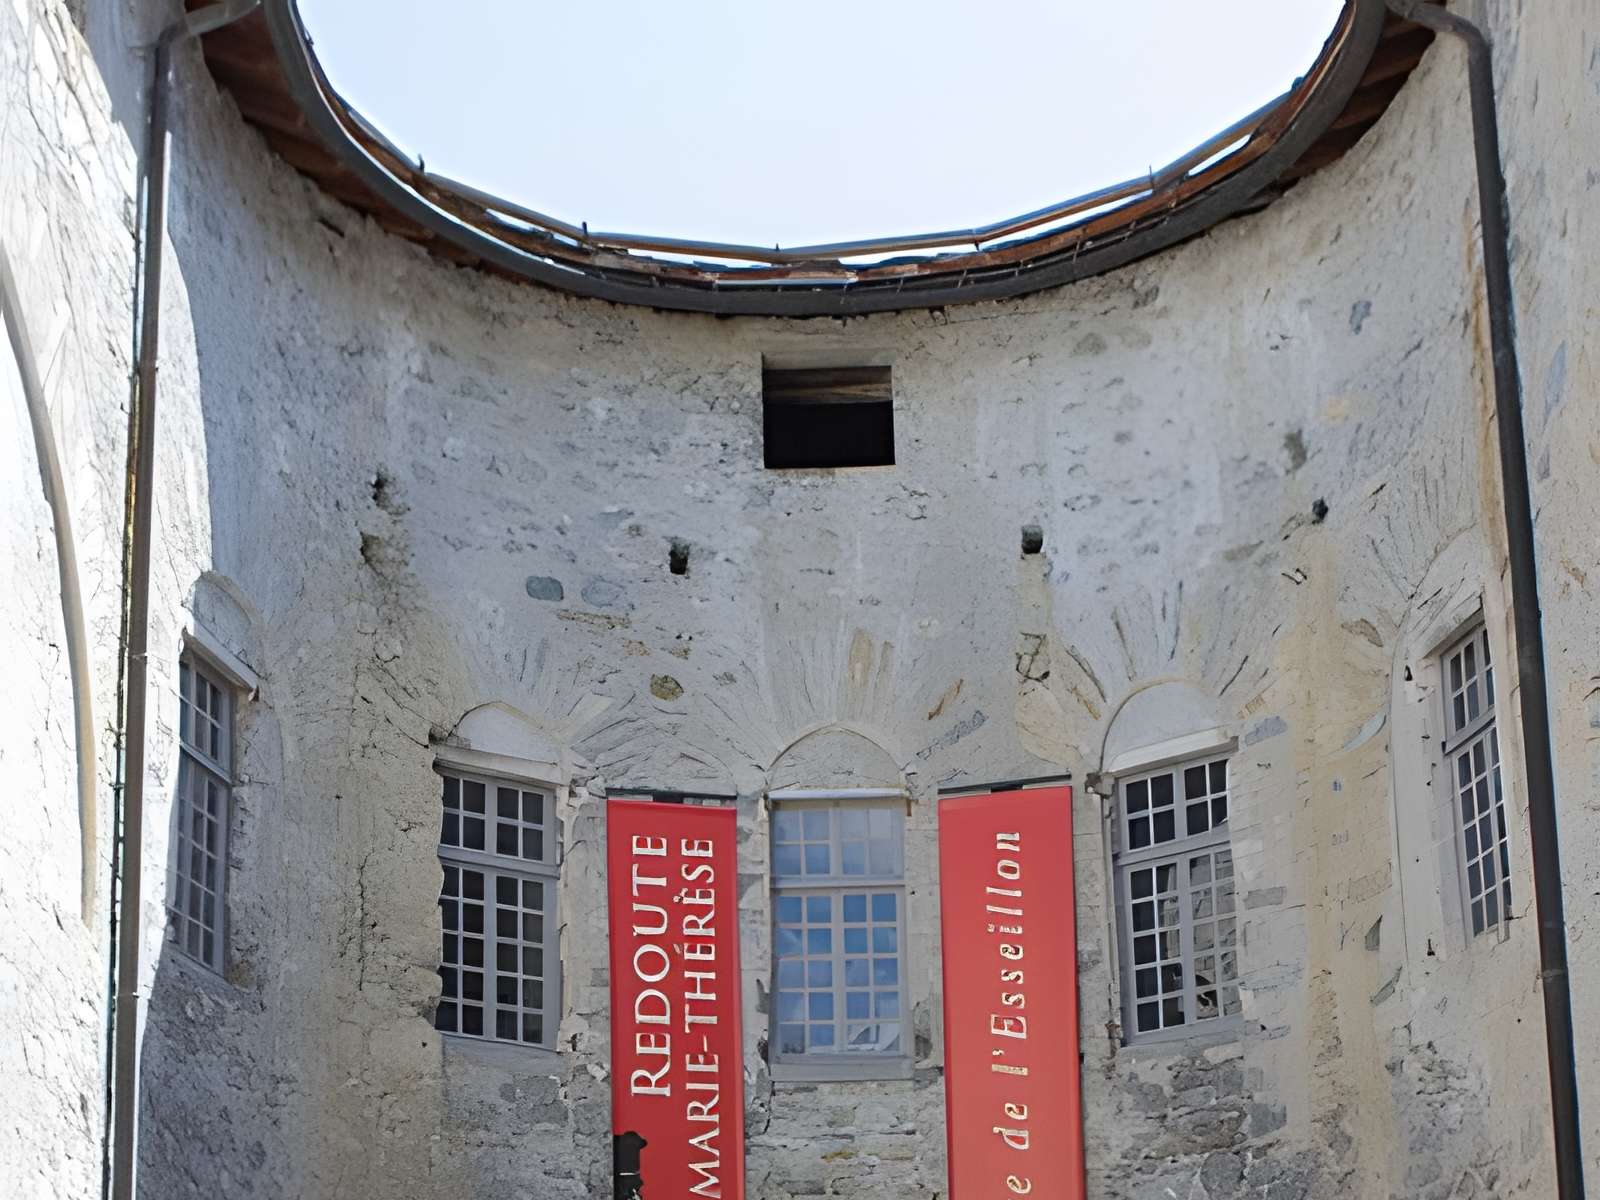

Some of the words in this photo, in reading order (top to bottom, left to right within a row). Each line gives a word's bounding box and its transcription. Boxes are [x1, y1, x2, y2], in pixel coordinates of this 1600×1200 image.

[630, 835, 671, 1097] REDOUTE
[673, 838, 721, 1199] MARIE-THÉRÈSE
[985, 832, 1029, 1077] l'Esseillon
[992, 1102, 1031, 1151] de
